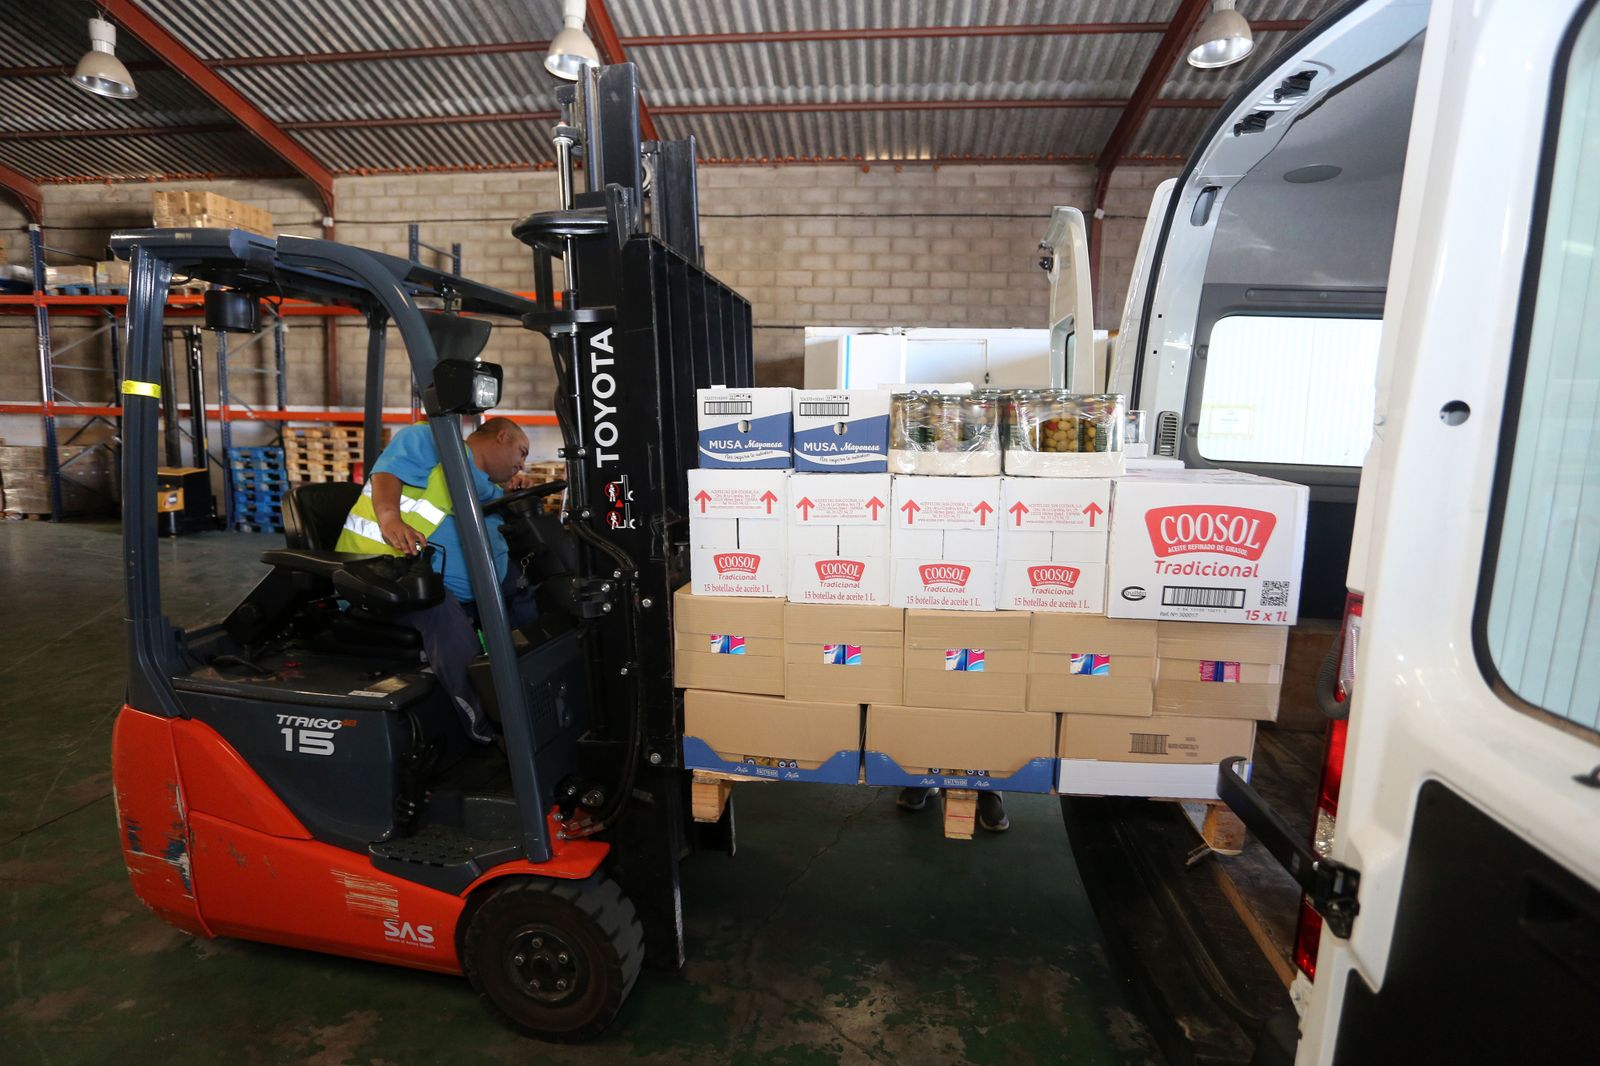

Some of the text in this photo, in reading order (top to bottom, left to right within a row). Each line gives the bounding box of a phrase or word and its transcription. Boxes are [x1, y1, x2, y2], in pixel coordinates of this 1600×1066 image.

[589, 327, 619, 469] TOYOTA
[709, 439, 784, 451] MUSA Mayonesa
[803, 442, 880, 453] MUSA Mayonesa
[1160, 512, 1261, 550] COOSOL
[1167, 543, 1187, 554] ACEITE
[1188, 543, 1216, 551] REFINADO
[1216, 544, 1225, 552] DE
[719, 555, 756, 569] COOSOL
[820, 563, 860, 577] COOSOL
[924, 567, 965, 582] COOSOL
[1154, 560, 1259, 578] Tradicional
[1033, 568, 1074, 583] COOSOL
[704, 584, 711, 592] 15
[711, 584, 734, 592] botellas
[735, 584, 742, 593] de
[820, 581, 860, 589] Tradicional
[923, 585, 965, 593] Tradicional
[1031, 587, 1074, 595] Tradicional
[804, 591, 812, 599] 15
[812, 591, 836, 600] botellas
[837, 592, 844, 600] de
[846, 592, 864, 601] aceite
[906, 596, 914, 604] 15
[915, 596, 940, 605] botellas
[941, 597, 949, 606] de
[950, 597, 969, 606] aceite
[1014, 597, 1022, 606] 15
[1023, 597, 1048, 607] botellas
[1049, 599, 1057, 607] de
[1058, 599, 1077, 608] aceite
[1244, 609, 1260, 621] 15
[1263, 612, 1271, 621] x
[281, 727, 335, 756] 15
[383, 919, 435, 943] SAS
